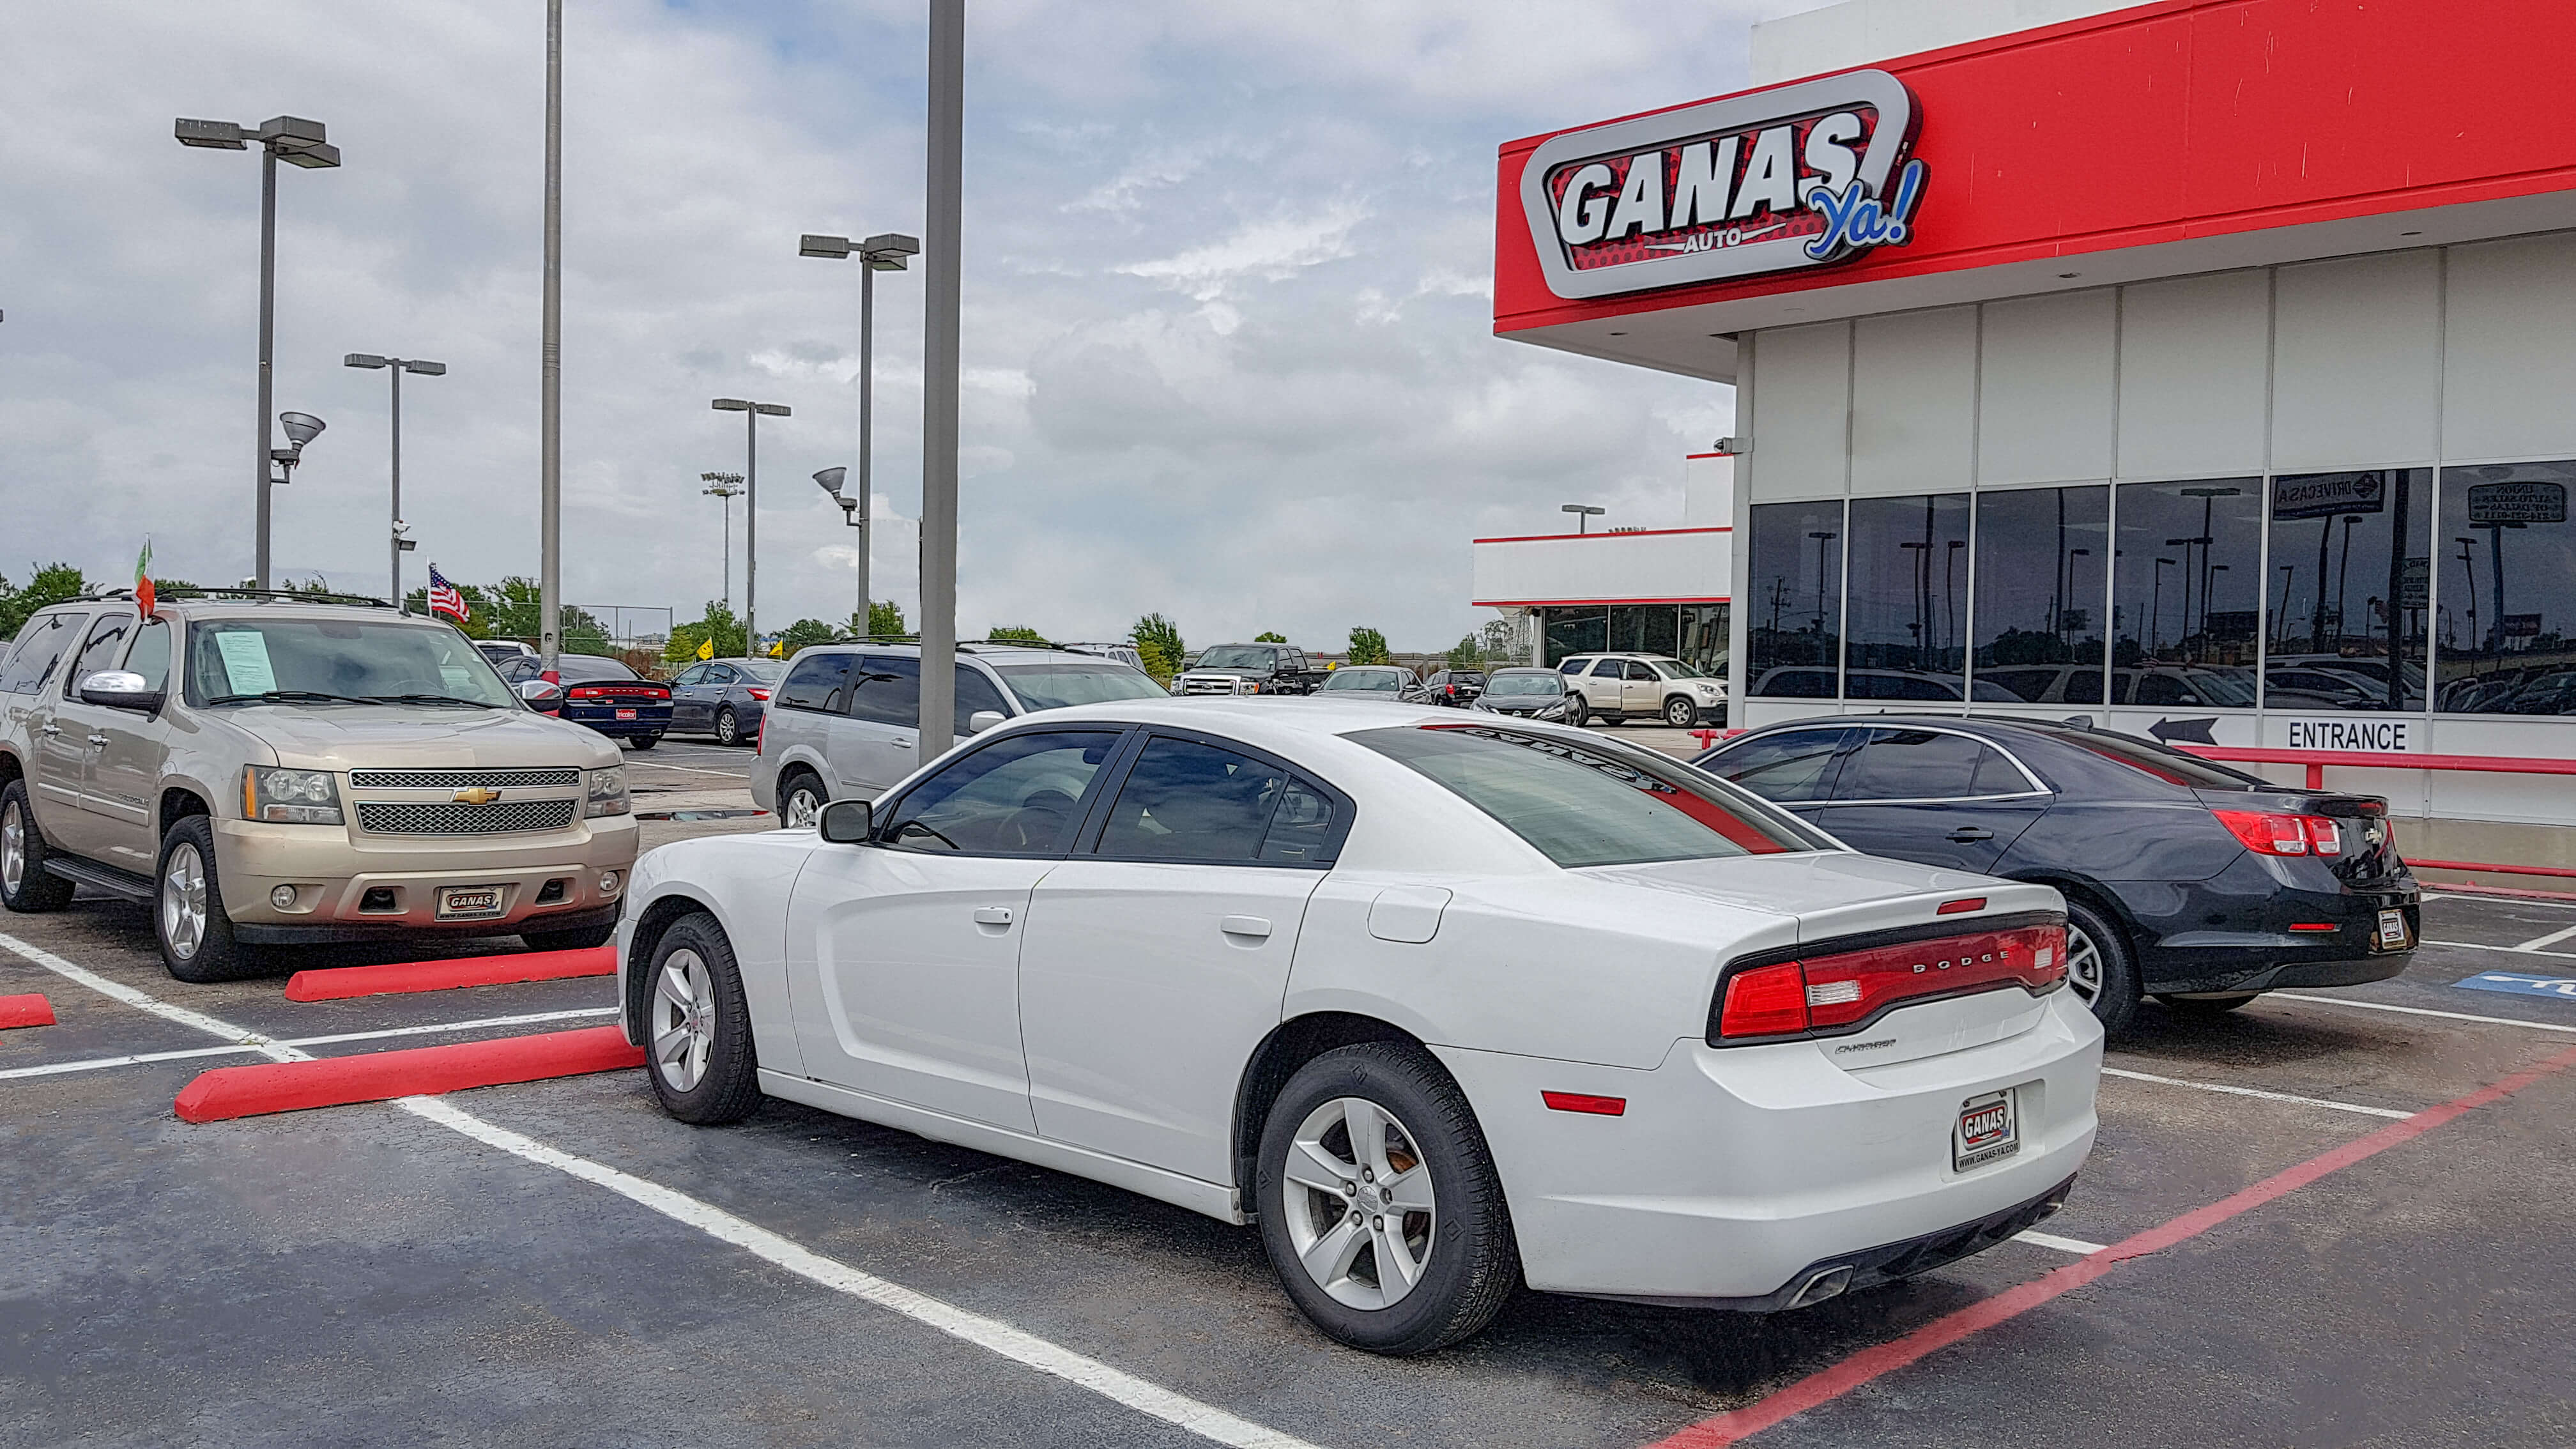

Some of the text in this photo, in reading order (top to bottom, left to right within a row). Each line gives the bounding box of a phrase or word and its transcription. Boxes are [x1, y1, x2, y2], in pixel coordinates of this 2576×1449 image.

[1560, 111, 1923, 261] GANAS Ya!
[1683, 227, 1743, 254] AUTO
[2289, 722, 2406, 750] ENTRANCE
[451, 895, 492, 907] GANAS
[1913, 951, 2009, 974] DODGE
[1965, 1108, 2004, 1138] GANAS
